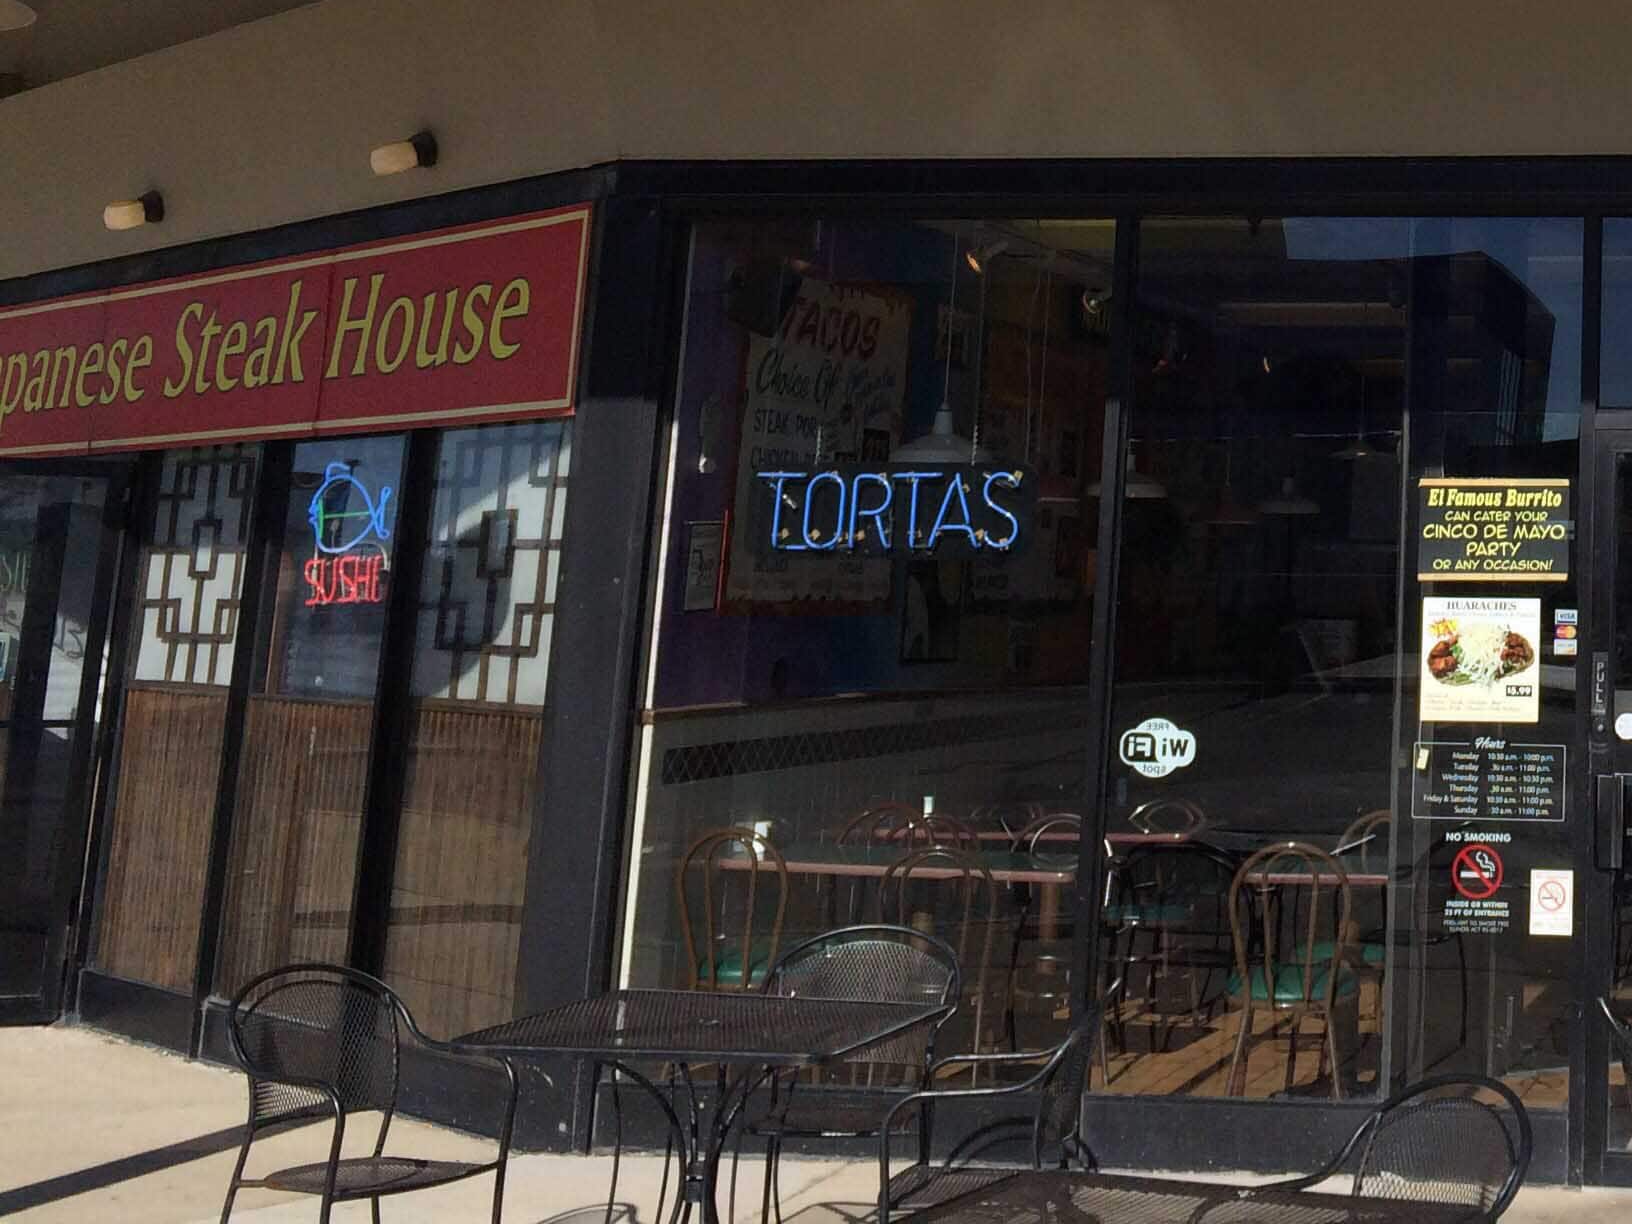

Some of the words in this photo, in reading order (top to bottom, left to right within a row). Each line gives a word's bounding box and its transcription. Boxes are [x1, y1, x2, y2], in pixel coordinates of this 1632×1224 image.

[0, 335, 154, 429] panese
[162, 279, 321, 400] Steak
[324, 272, 533, 381] House
[1427, 488, 1444, 507] El
[1446, 488, 1502, 507] Famous
[1505, 488, 1562, 507] Burrito
[756, 471, 1024, 551] TORTAS
[1445, 511, 1470, 521] CAN
[1474, 511, 1510, 521] CATER
[1514, 511, 1548, 521] YOUR
[1423, 524, 1478, 539] CINCO
[1484, 524, 1508, 539] DE
[1513, 524, 1565, 539] MAYO
[1466, 541, 1521, 557] PARTY
[1433, 559, 1451, 570] OR
[1455, 559, 1480, 570] ANY
[1483, 559, 1553, 571] OCCASION!
[304, 555, 387, 605] SUSHI
[1447, 600, 1517, 610] HUARACHES
[1596, 662, 1605, 704] PULL
[1446, 832, 1461, 841] NO
[1464, 832, 1511, 842] SMOKING
